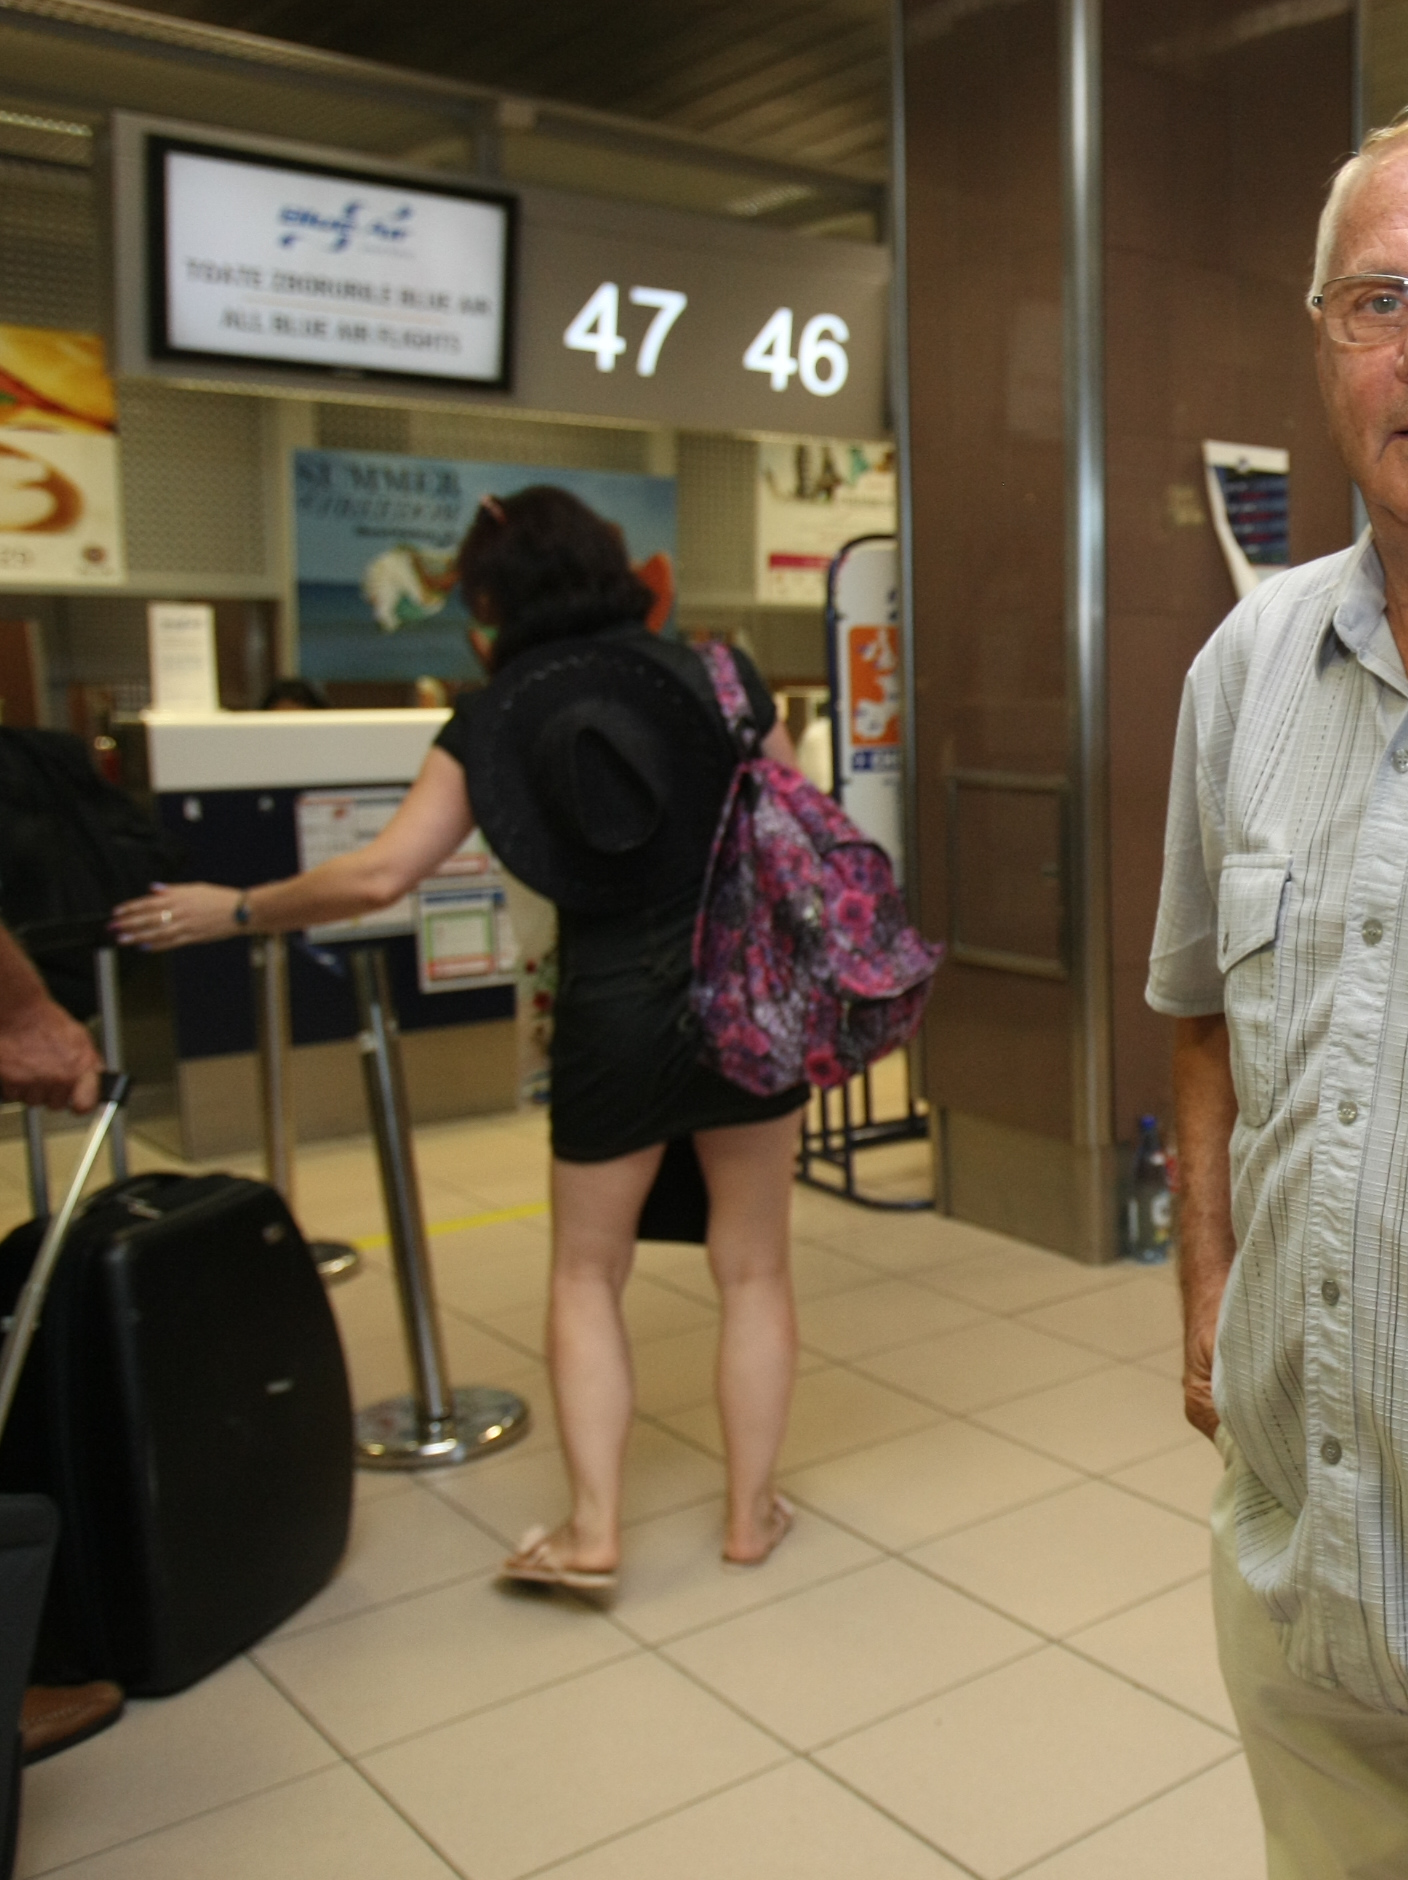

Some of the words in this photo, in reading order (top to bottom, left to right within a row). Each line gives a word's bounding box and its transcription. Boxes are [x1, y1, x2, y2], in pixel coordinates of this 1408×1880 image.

[400, 284, 450, 311] BLUE
[459, 292, 493, 317] AIR
[220, 308, 263, 336] ALL
[271, 312, 329, 342] BLUE
[336, 318, 371, 345] AIR
[563, 281, 688, 377] 47
[742, 306, 850, 397] 46
